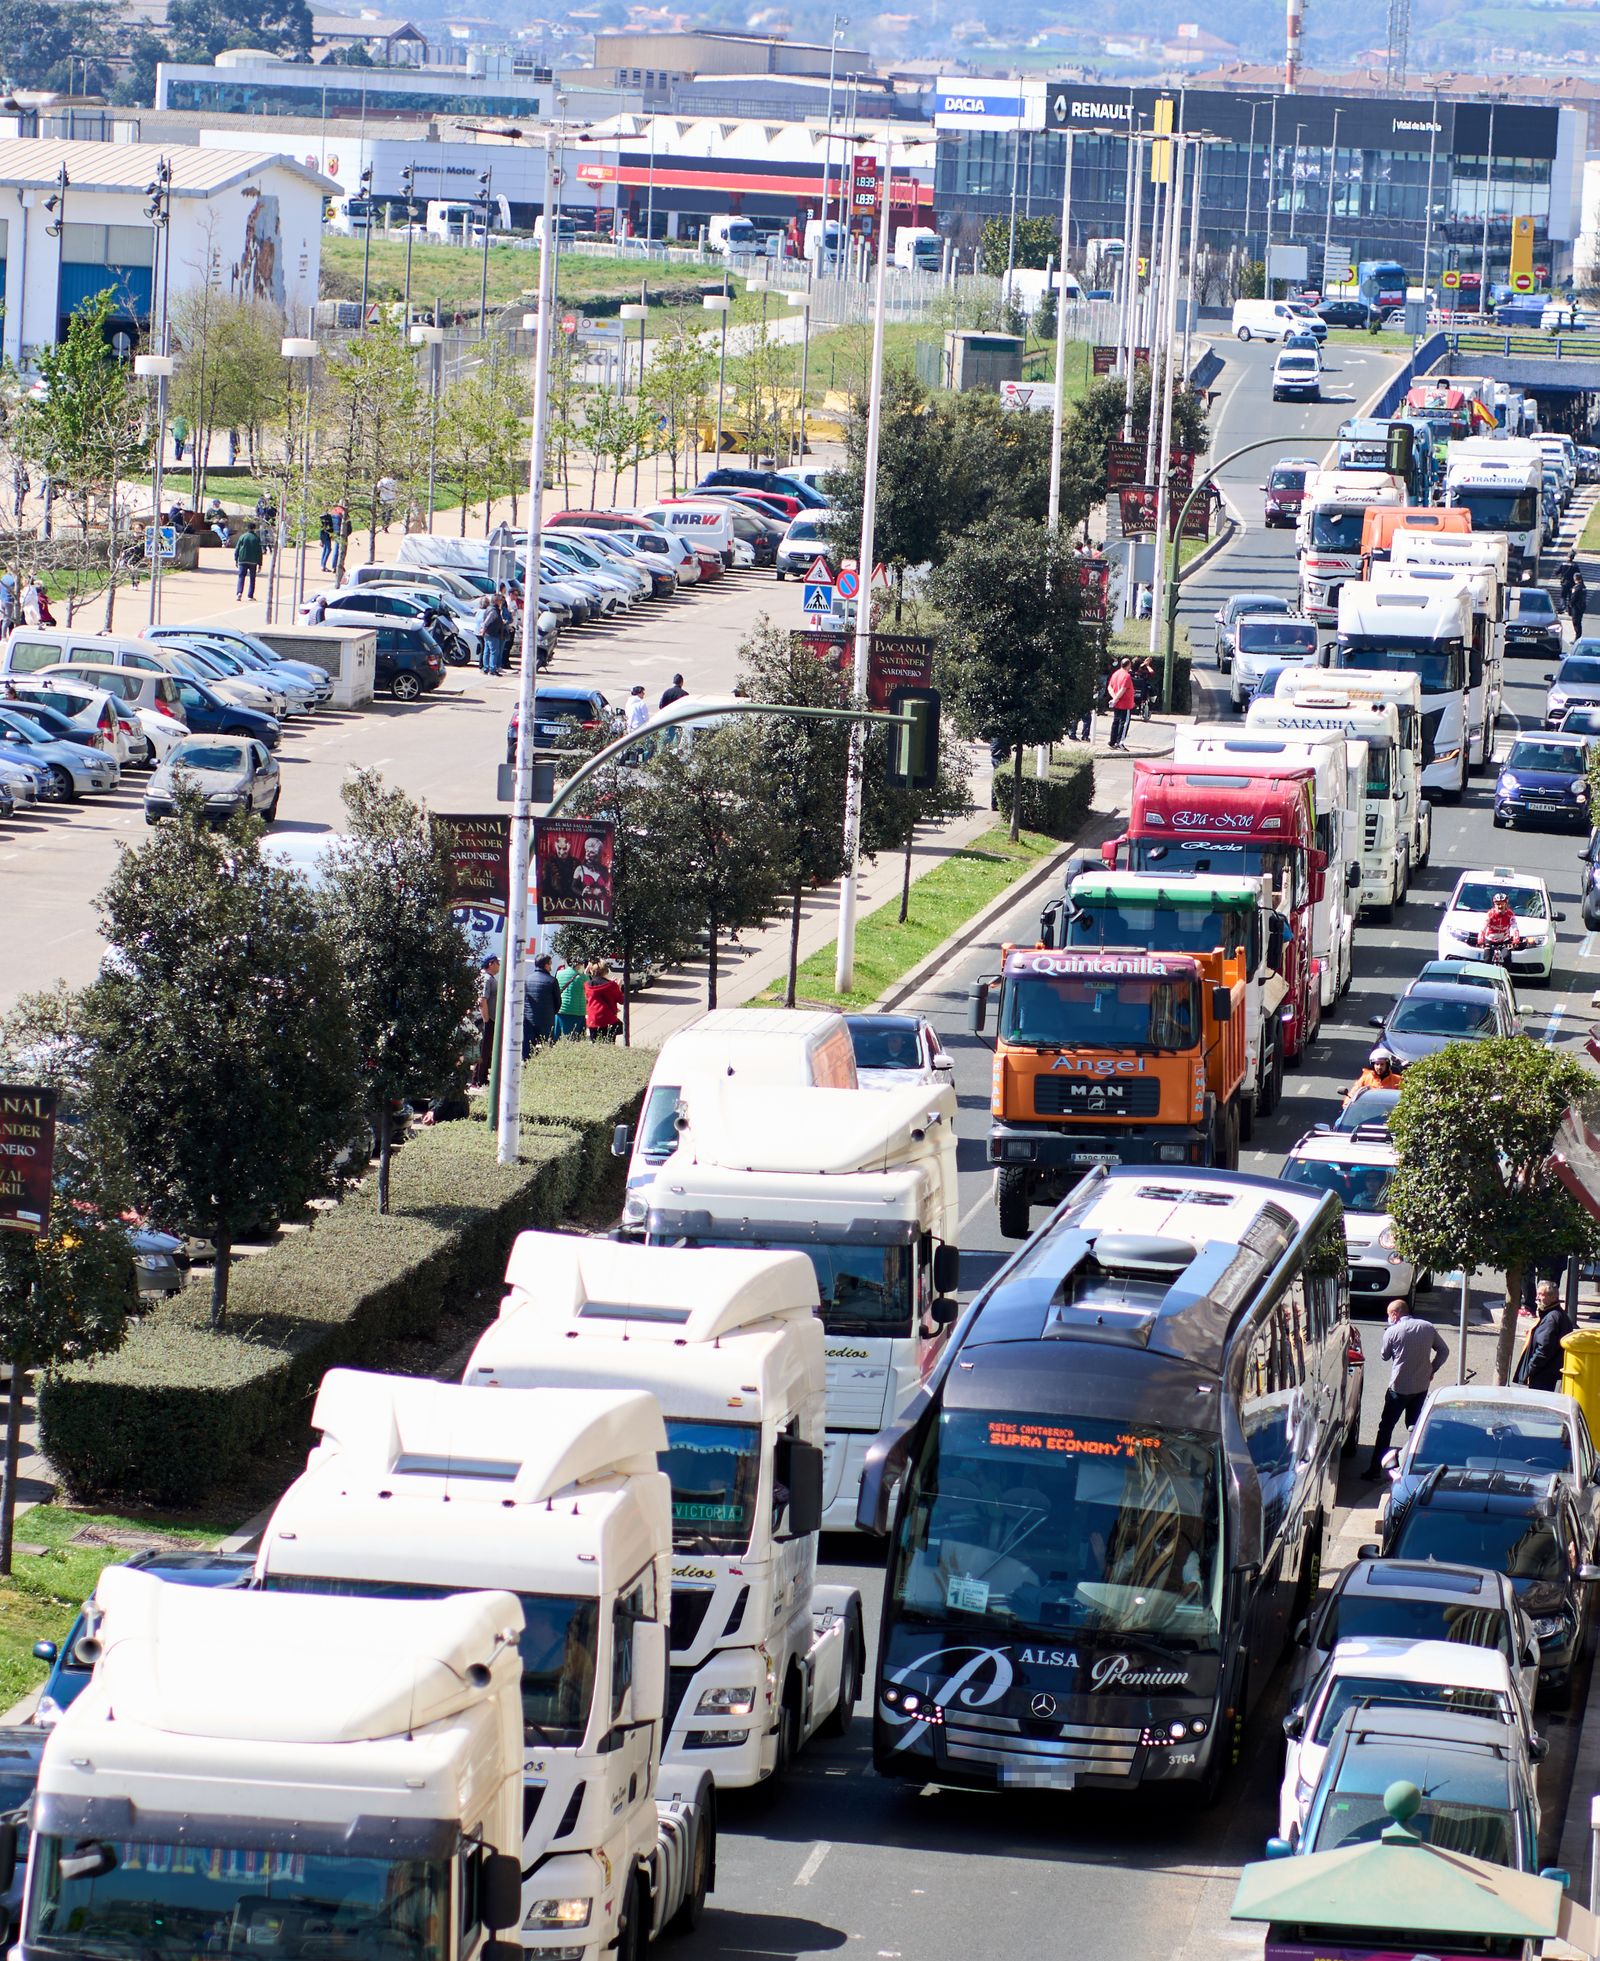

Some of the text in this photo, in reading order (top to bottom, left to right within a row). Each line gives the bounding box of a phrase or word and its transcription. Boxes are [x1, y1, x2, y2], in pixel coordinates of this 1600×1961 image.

[945, 98, 985, 112] DACIA
[1072, 102, 1134, 120] RENAULT
[447, 166, 476, 176] Motor
[1111, 444, 1143, 454] BACANAL
[1472, 476, 1524, 484] TRANSTIRA
[672, 514, 721, 525] MRW
[875, 640, 930, 656] BACANAL
[879, 654, 925, 667] SANTANDER
[882, 667, 922, 678] SARDINERO
[1277, 717, 1358, 731] SARABIA
[450, 853, 500, 862] SARDINERO
[542, 896, 610, 916] BACANAL
[1032, 956, 1168, 976] Quintanilla
[1052, 1055, 1144, 1075] Angel
[1071, 1085, 1123, 1097] MAN
[825, 1346, 869, 1359] edios
[851, 1369, 886, 1379] XF
[989, 1432, 1122, 1456] SUPRA ECONOMY
[675, 1505, 736, 1520] VICTORIA
[1019, 1648, 1080, 1668] ALSA
[1090, 1655, 1191, 1692] Premium
[1168, 1754, 1195, 1765] 3764
